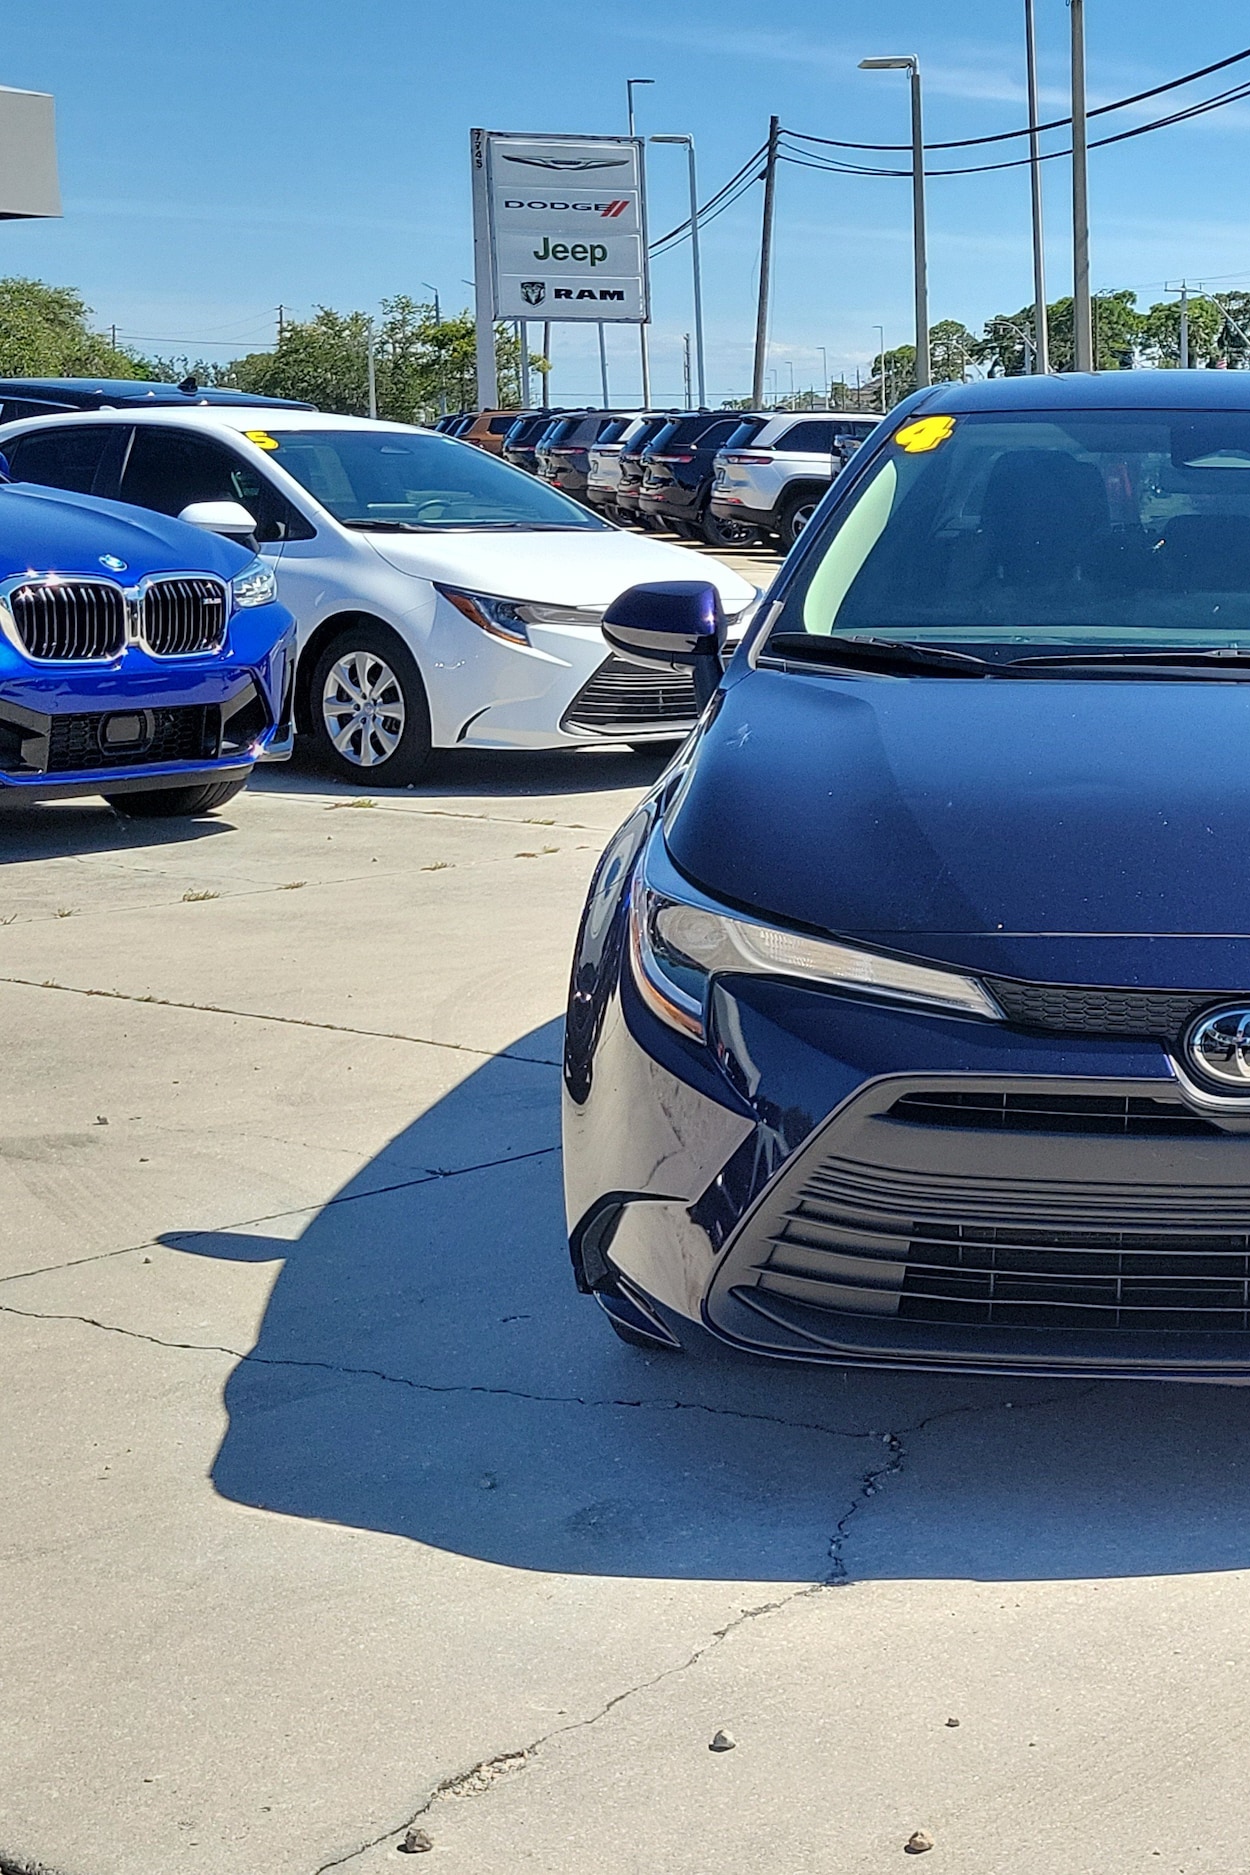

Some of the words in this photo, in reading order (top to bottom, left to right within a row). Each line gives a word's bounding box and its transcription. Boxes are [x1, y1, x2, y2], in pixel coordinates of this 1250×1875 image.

[504, 201, 610, 211] DODGE
[534, 237, 608, 266] Jeep
[554, 288, 625, 301] RAM
[895, 416, 957, 453] 4
